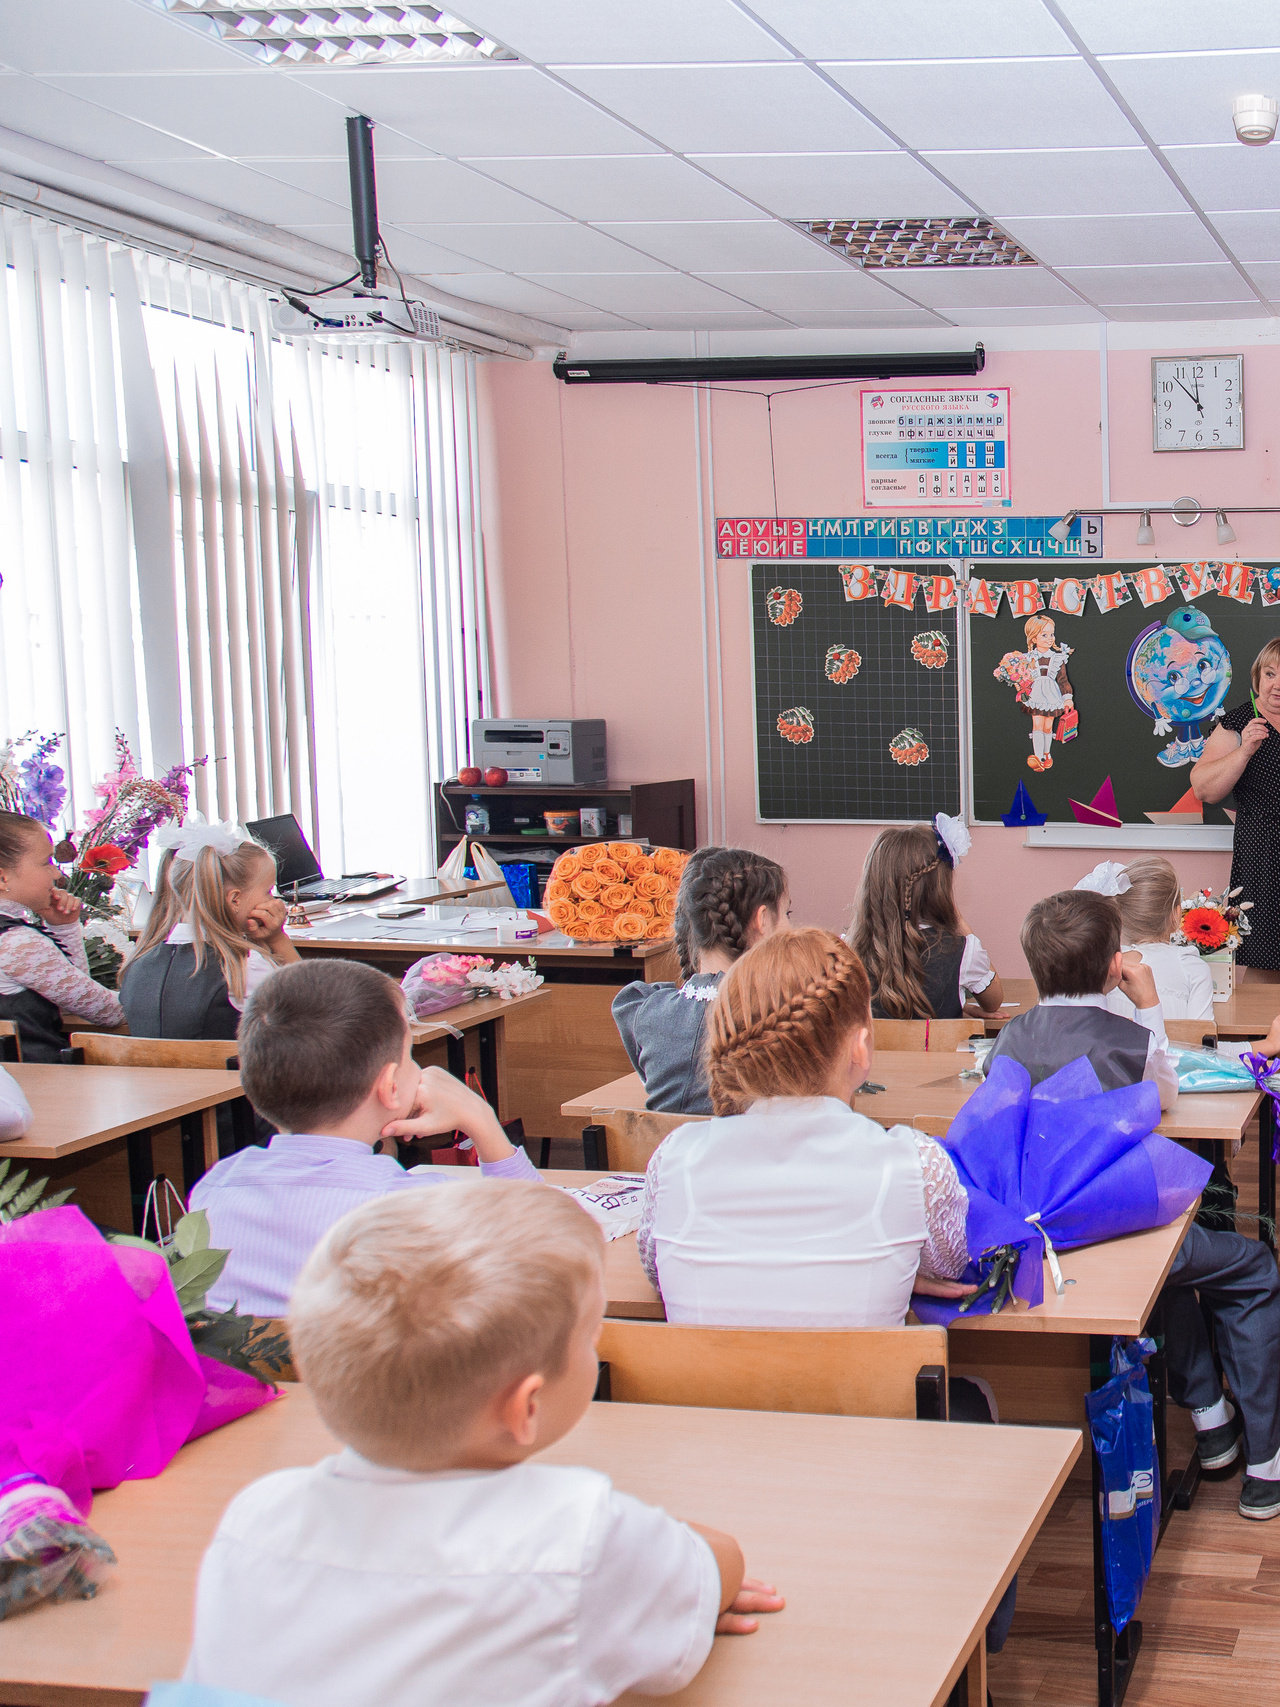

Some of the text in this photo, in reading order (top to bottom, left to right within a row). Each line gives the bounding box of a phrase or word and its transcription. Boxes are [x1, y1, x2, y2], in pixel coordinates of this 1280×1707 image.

[1176, 366, 1185, 379] 11
[1192, 366, 1204, 379] 12
[1214, 366, 1218, 378] 1
[1162, 380, 1174, 393] 10
[1224, 379, 1233, 392] 2
[890, 395, 945, 403] СОГЛАСНЫЕ
[1163, 399, 1172, 412] 9
[1225, 397, 1233, 410] 3
[1164, 417, 1172, 430] 8
[1225, 415, 1233, 427] 4
[1178, 429, 1186, 442] 7
[1195, 429, 1203, 442] 6
[1212, 429, 1220, 442] 5
